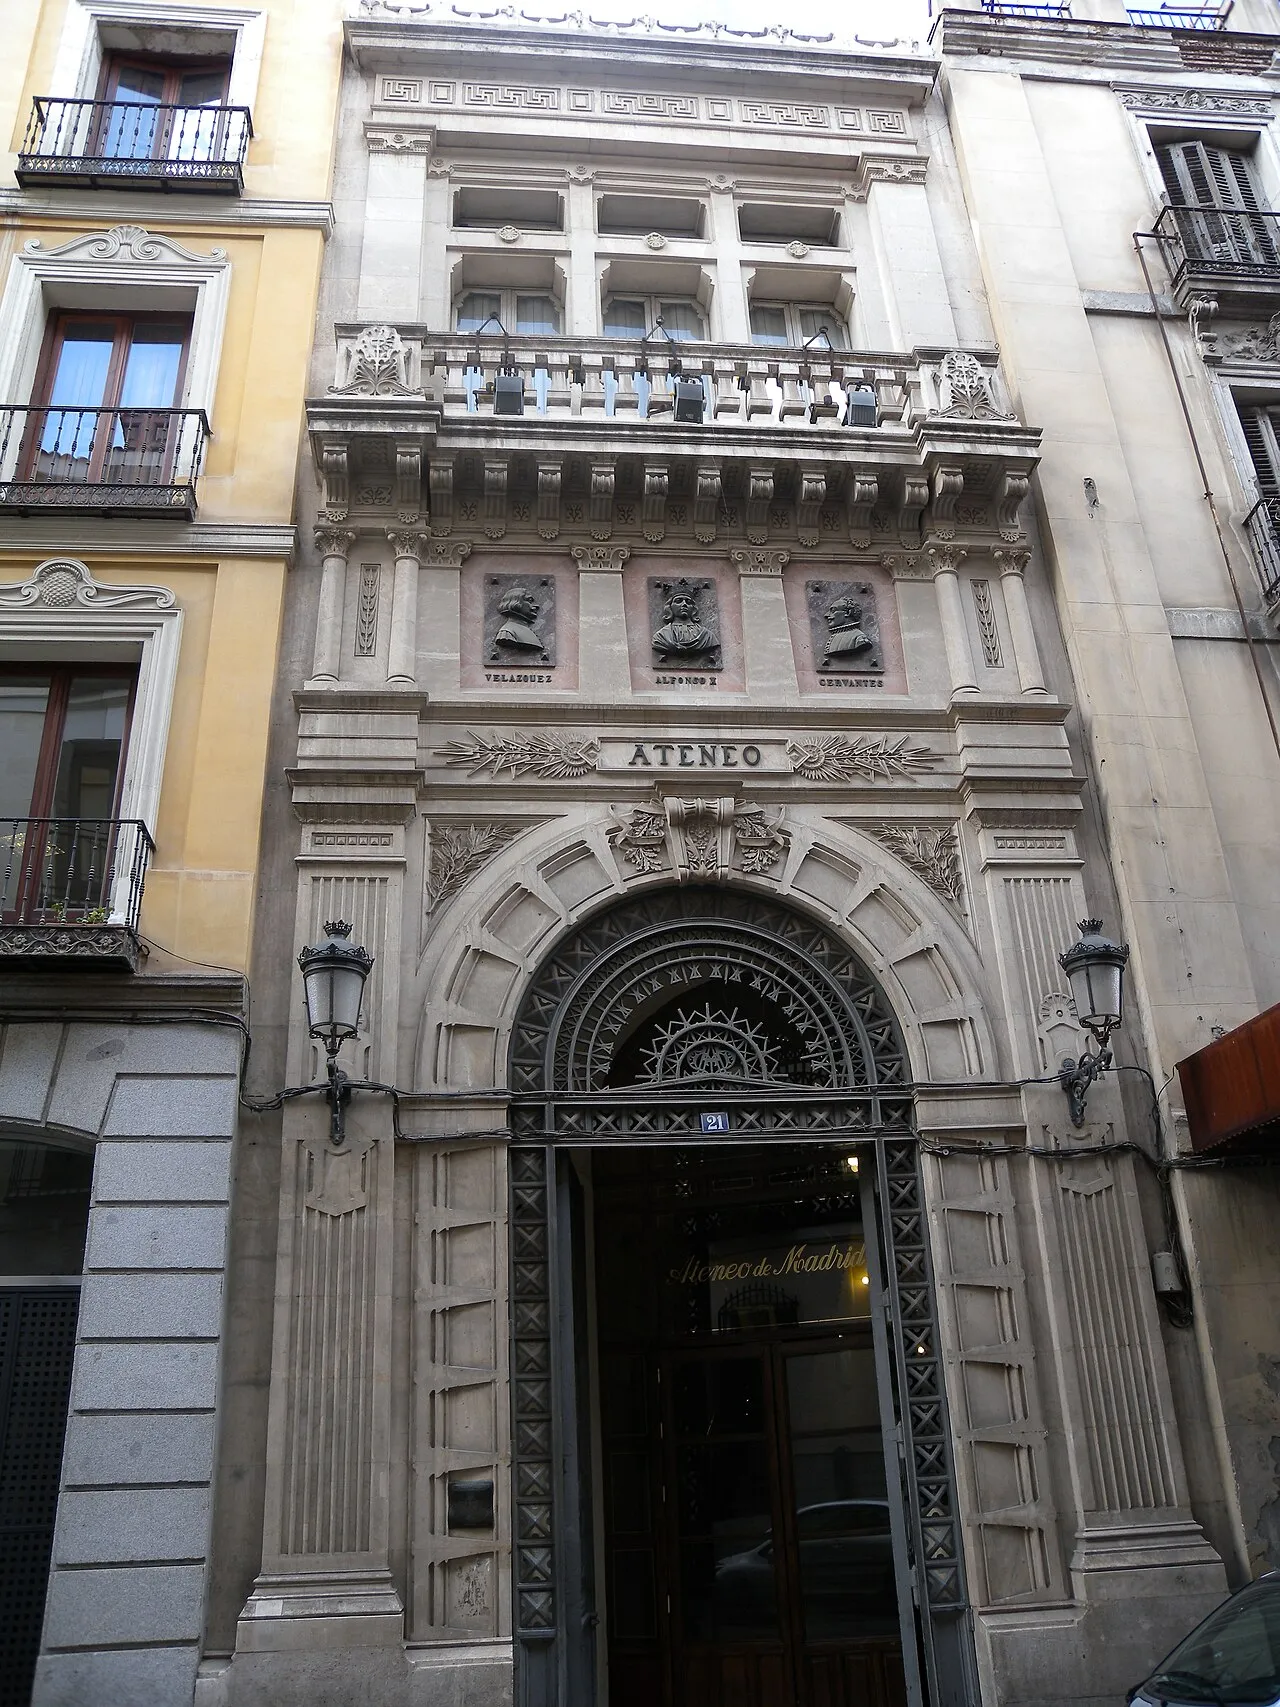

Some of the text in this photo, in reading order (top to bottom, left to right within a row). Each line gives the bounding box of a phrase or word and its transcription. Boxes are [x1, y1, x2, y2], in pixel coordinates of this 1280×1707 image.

[655, 676, 717, 686] ALFONSO X
[819, 678, 884, 688] CERVANTES
[628, 744, 761, 767] ATENEO
[706, 1115, 724, 1130] 21
[666, 1243, 866, 1285] Ateneo de Madrid
